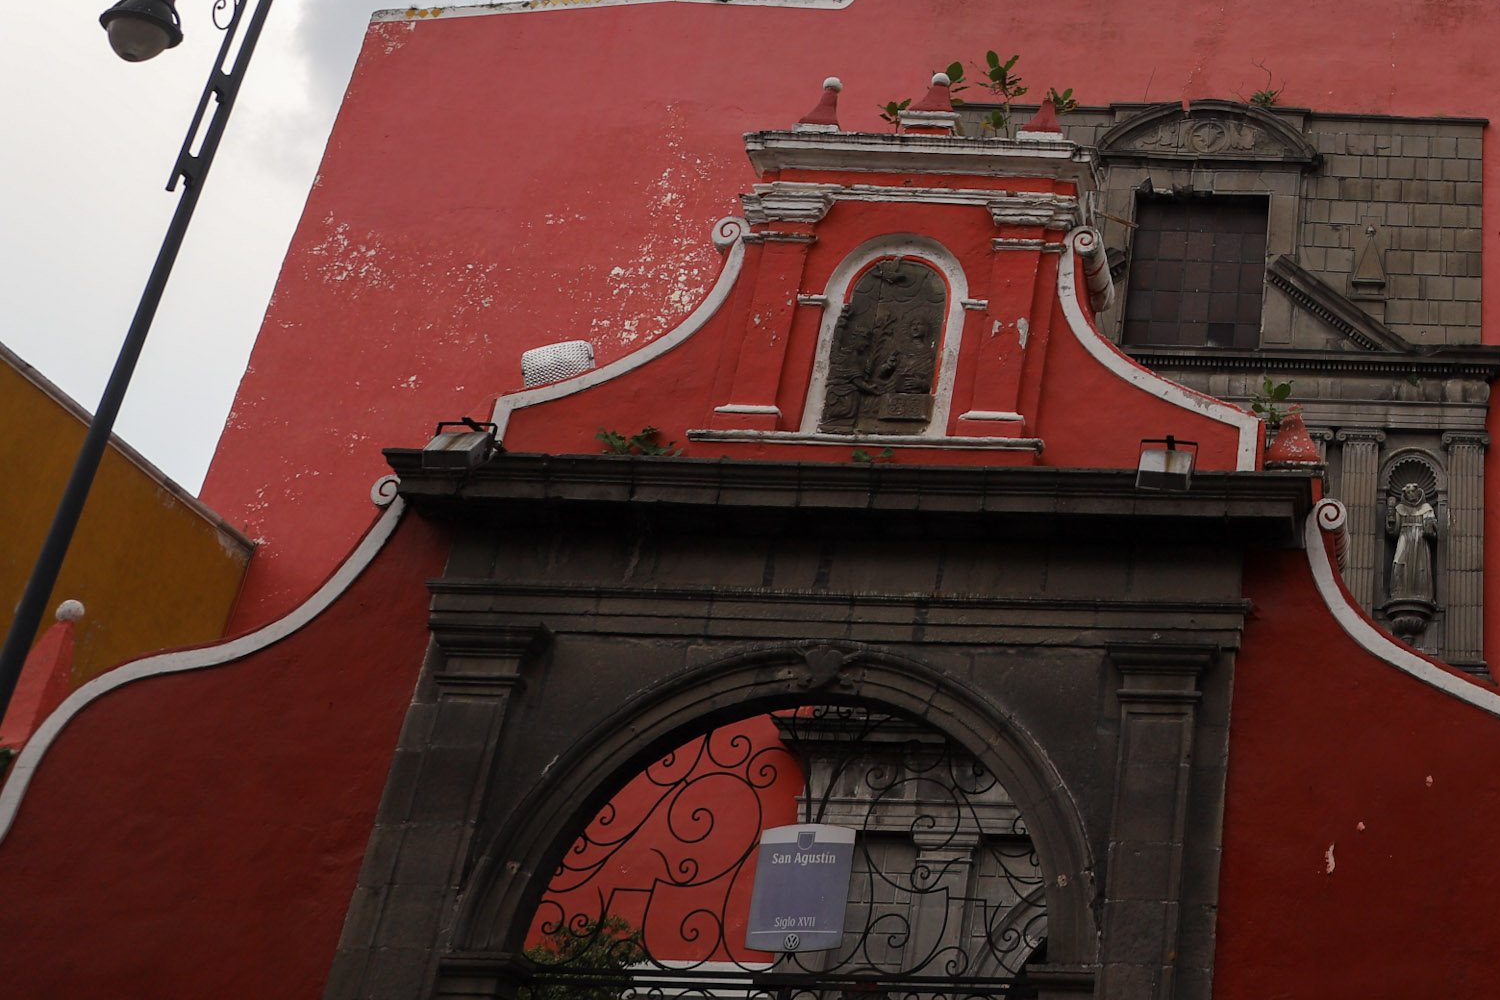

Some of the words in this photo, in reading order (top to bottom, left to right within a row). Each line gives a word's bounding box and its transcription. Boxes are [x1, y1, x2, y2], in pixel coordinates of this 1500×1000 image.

[772, 853, 791, 864] San
[794, 852, 836, 866] Agustín
[774, 916, 795, 929] Siglo
[797, 917, 816, 927] XVII
